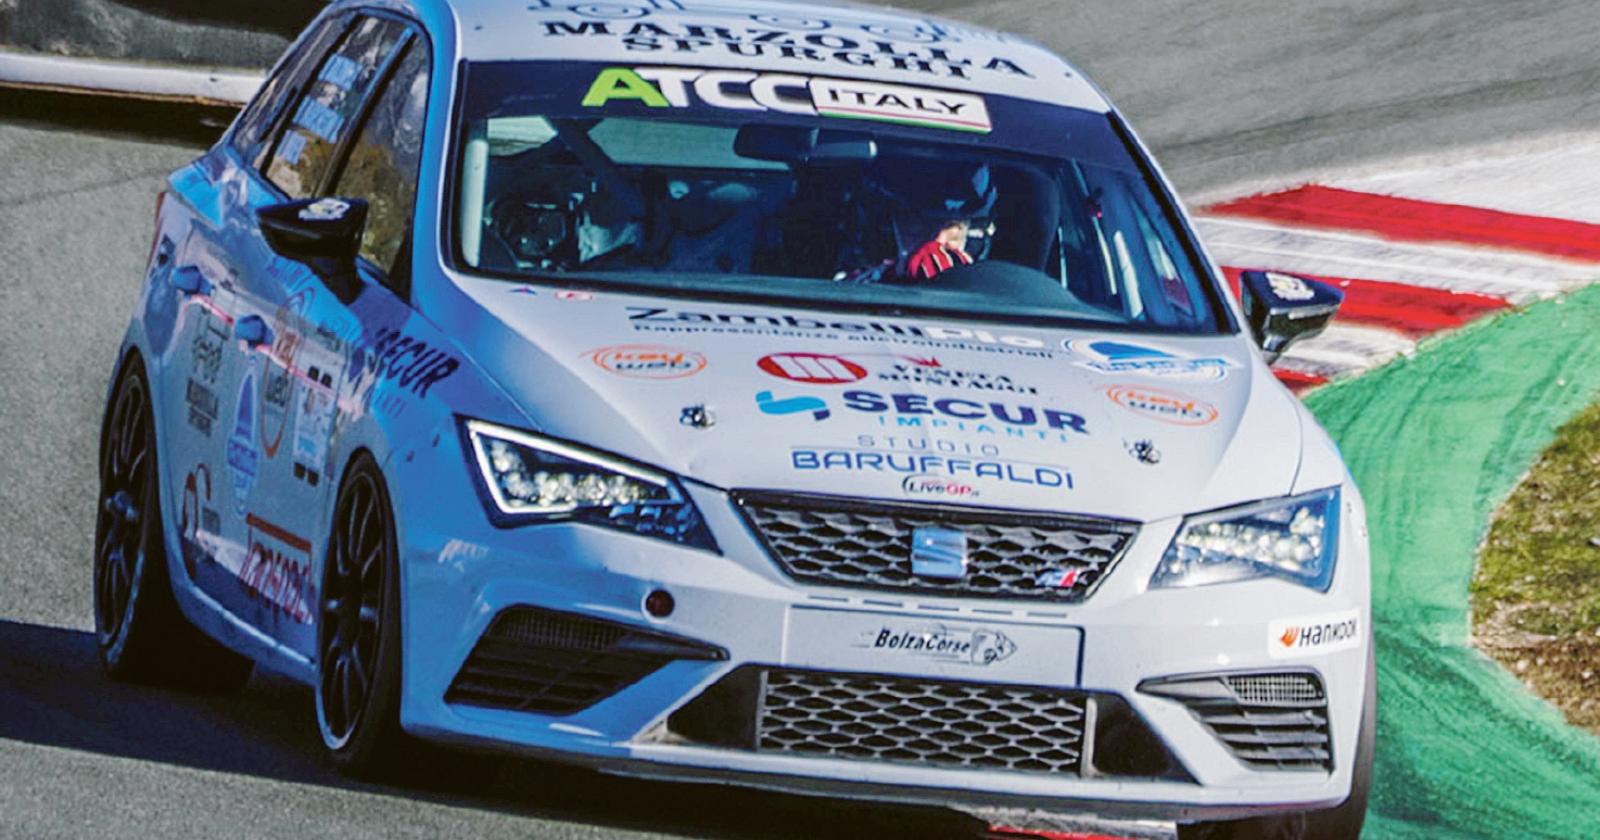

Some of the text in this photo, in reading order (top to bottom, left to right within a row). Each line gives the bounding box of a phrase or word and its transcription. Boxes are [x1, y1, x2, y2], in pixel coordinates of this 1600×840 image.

[540, 21, 1036, 78] MARZOLLA
[623, 37, 971, 79] SPURGHI
[582, 67, 965, 116] ATCC ITALY
[843, 391, 1089, 434] SECUR
[879, 414, 1069, 443] IMPIANTI
[857, 434, 1000, 457] STUDIO
[791, 450, 1074, 489] BARUFFALDI
